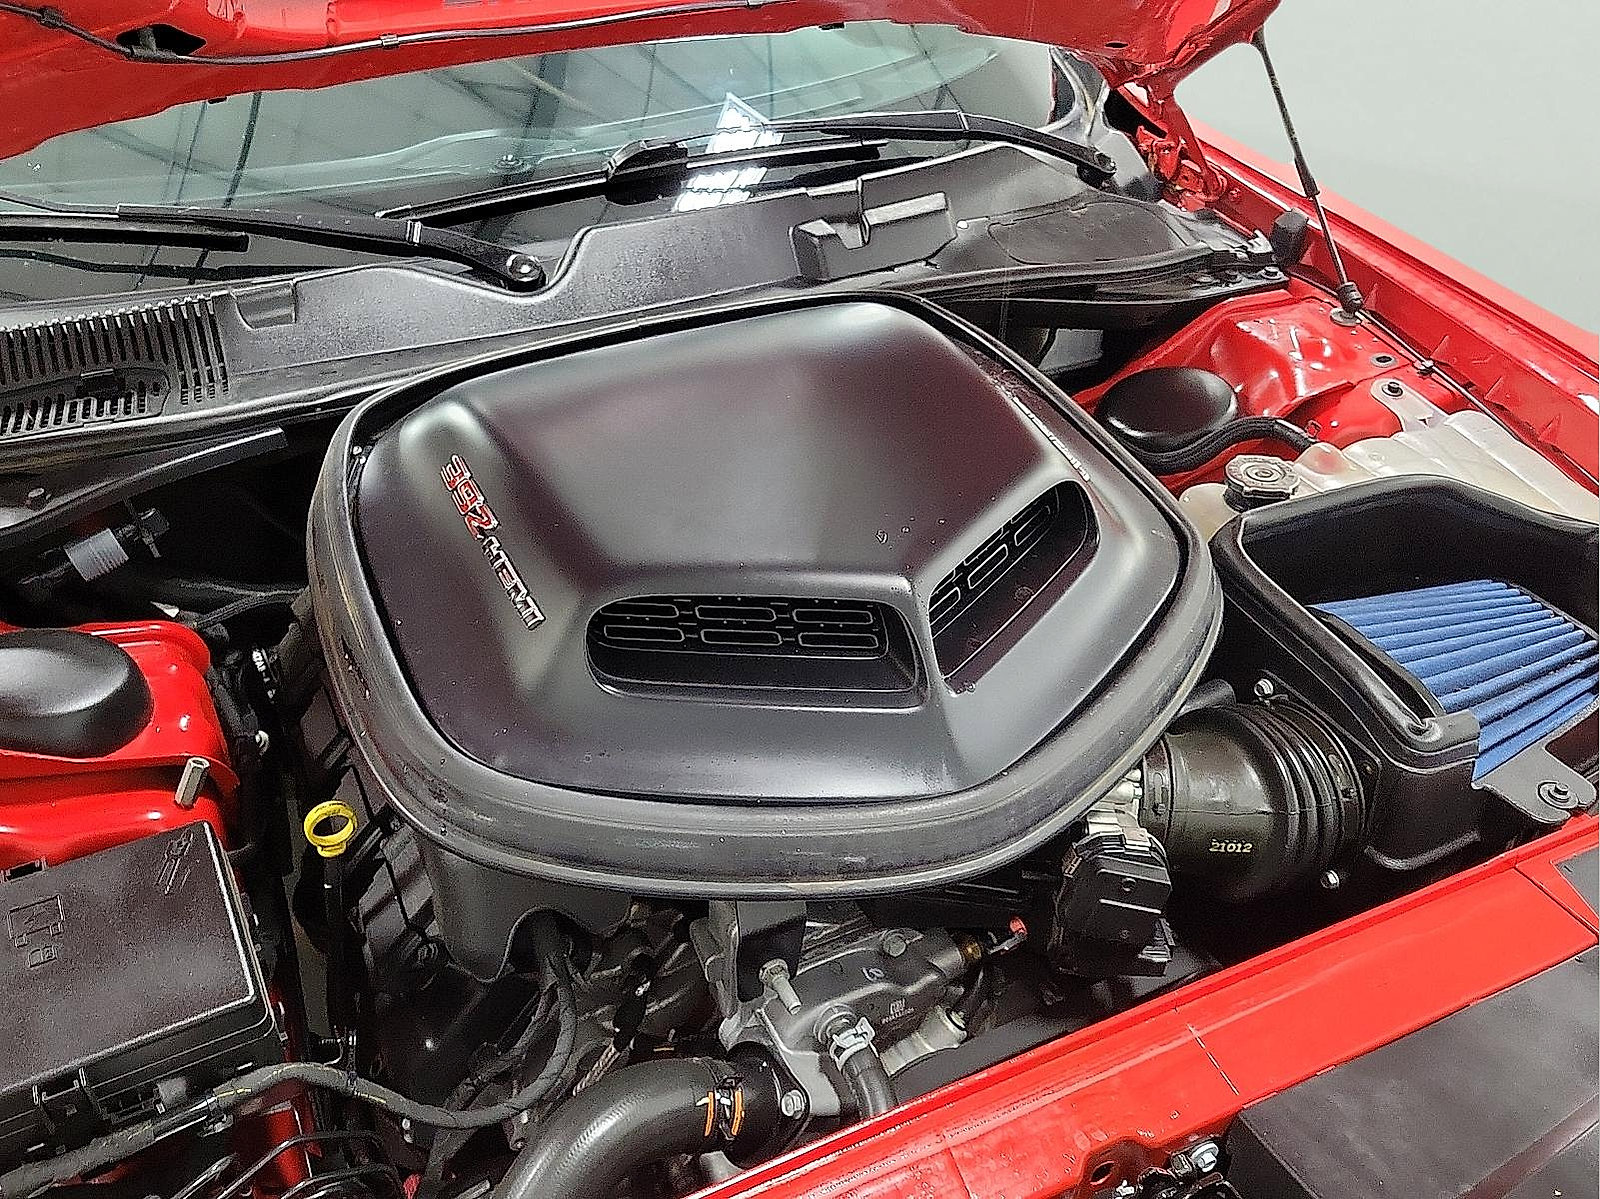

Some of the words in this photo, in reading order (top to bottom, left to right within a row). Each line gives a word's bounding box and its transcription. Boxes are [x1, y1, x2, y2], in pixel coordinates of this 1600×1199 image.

[440, 454, 499, 540] 392
[482, 535, 546, 630] HEMI
[1209, 838, 1253, 853] 21012
